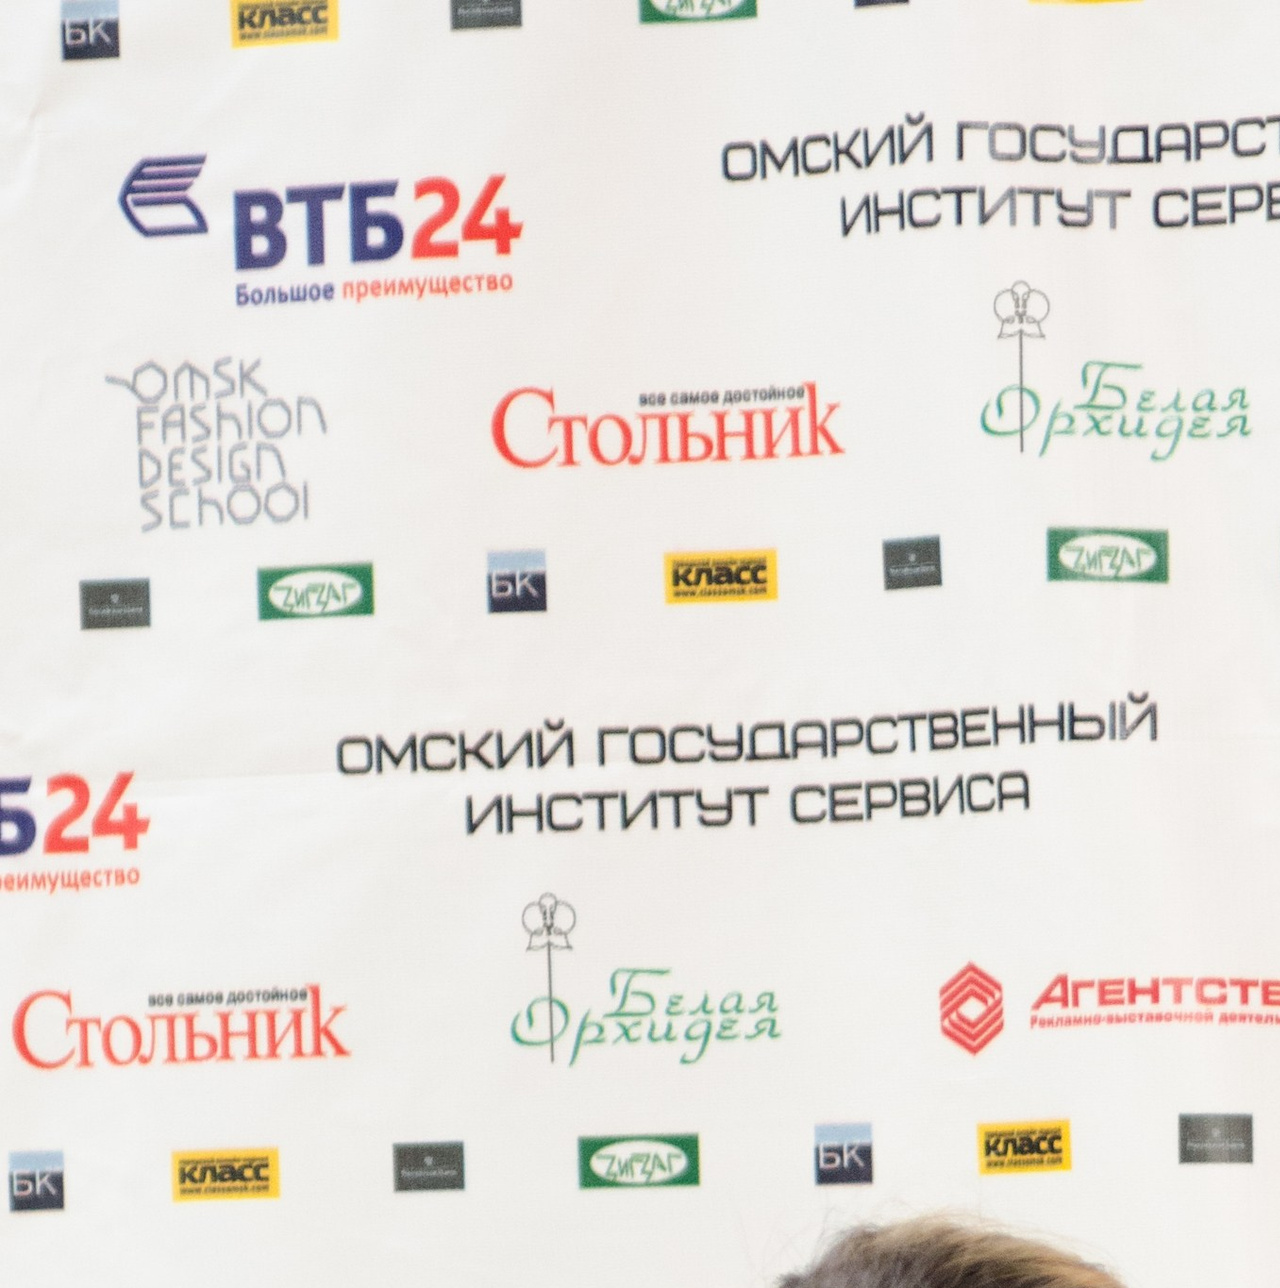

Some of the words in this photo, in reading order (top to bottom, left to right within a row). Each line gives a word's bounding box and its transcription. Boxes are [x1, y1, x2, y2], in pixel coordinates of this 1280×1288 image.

[65, 18, 111, 45] БК
[721, 111, 934, 184] ОМСКИЙ
[232, 174, 524, 272] ВТБ24
[840, 185, 1132, 238] ИНСТИТУТ
[235, 282, 335, 307] Большое
[342, 274, 513, 303] преимущество
[491, 570, 538, 598] БК
[336, 717, 576, 777] ОМСКИЙ
[597, 691, 1158, 767] ГОСУДАРСТВЕННЫЙ
[465, 785, 770, 836] ИНСТИТУТ
[789, 770, 1030, 826] СЕРВИСА
[0, 867, 140, 895] еимущество
[818, 1143, 865, 1170] БК
[13, 1169, 56, 1195] БК
